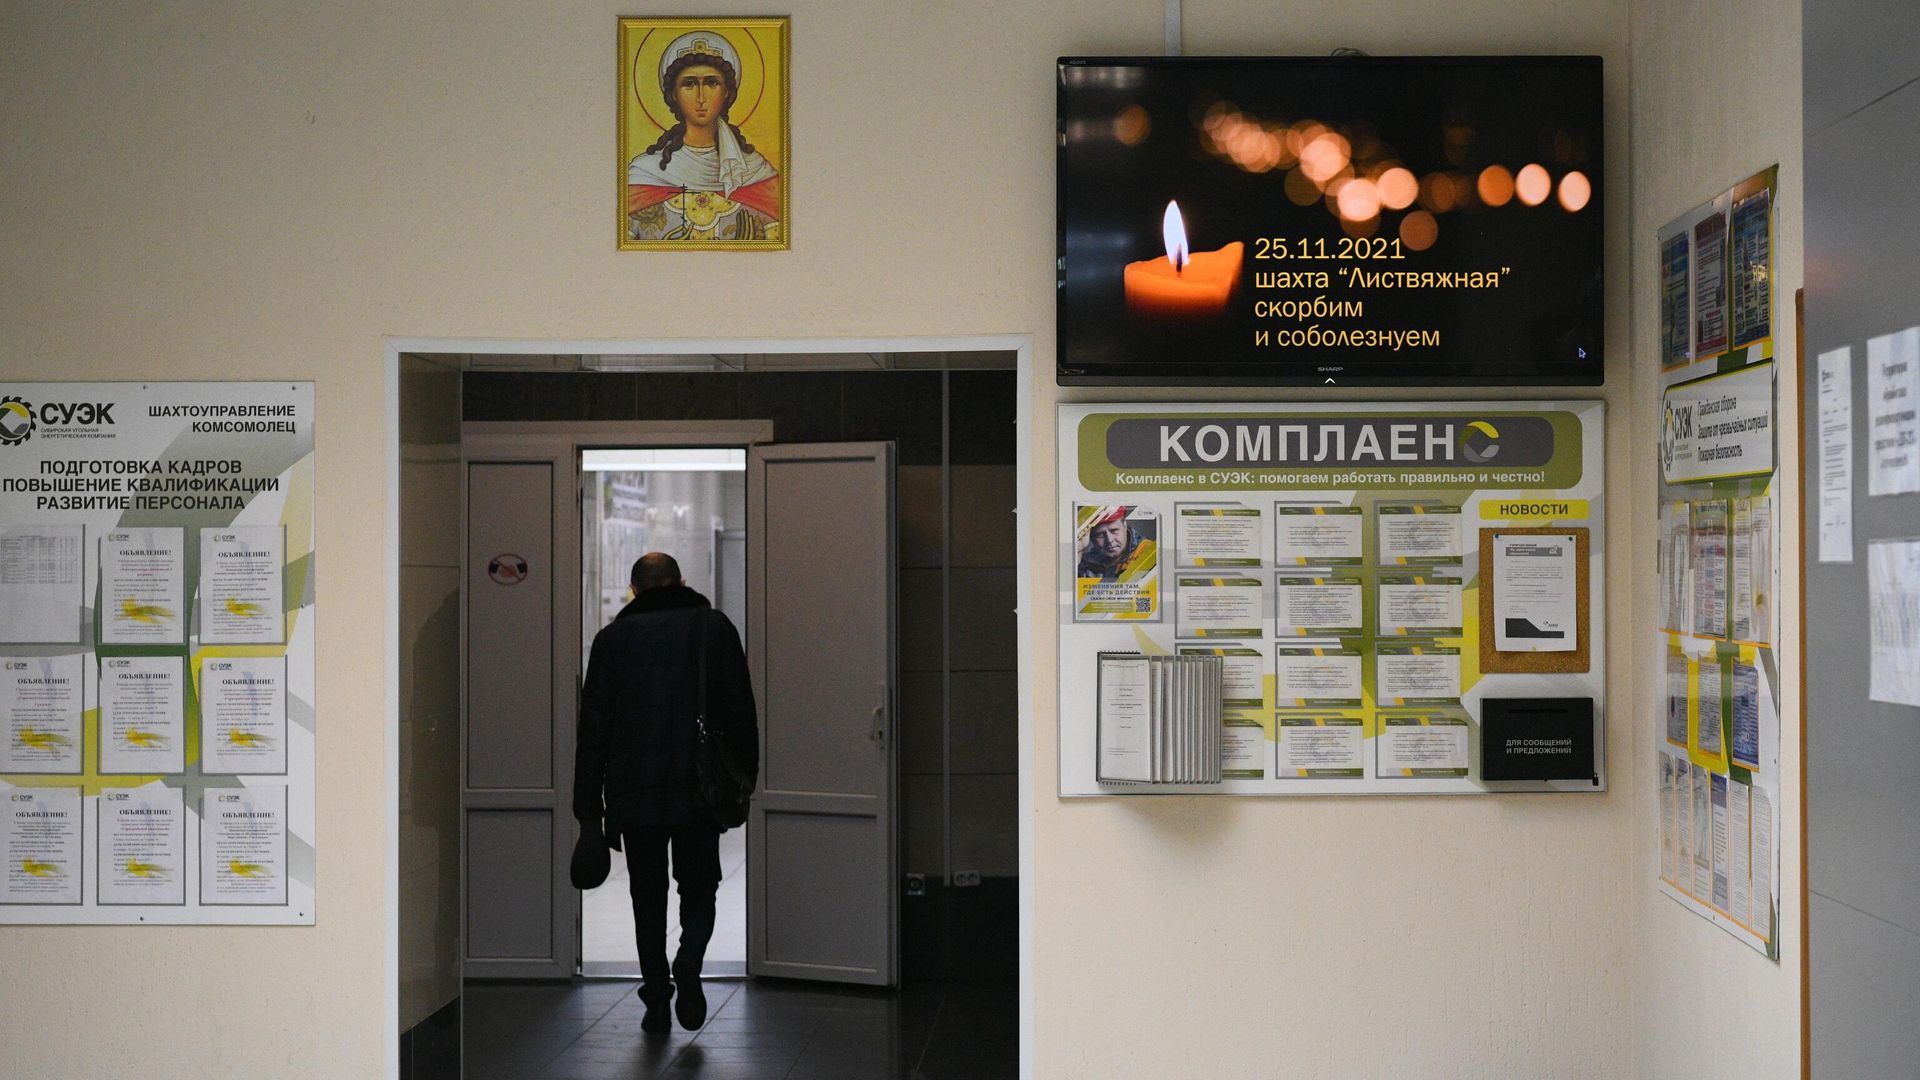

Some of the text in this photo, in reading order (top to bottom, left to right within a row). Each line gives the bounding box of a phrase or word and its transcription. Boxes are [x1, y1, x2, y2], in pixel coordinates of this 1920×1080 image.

[1255, 237, 1406, 260] 25.11.2021
[1255, 271, 1329, 289] шахта
[1254, 295, 1363, 321] скорбим
[1255, 324, 1440, 351] и соболезнуем
[40, 402, 115, 425] СУЭК
[148, 405, 296, 418] ШАХТОУПРАВЛЕНИЕ
[192, 421, 296, 435] КОМСОМОЛЕЦ
[1675, 405, 1693, 441] СУЭК
[40, 460, 242, 477] ПОДГОТОВКА КАДРОВ
[3, 477, 279, 494] ПОВЫШЕНИЕ КВАЛИФИКАЦИИ
[1116, 471, 1545, 486] Комплаенс в СУЭК: помогаем работать правильно и честно!
[37, 496, 245, 510] РАЗВИТИЕ ПЕРСОНАЛА
[1500, 504, 1569, 516] НОВОСТИ
[1506, 738, 1572, 747] ДЛЯ СООБЩЕНИЙ
[1514, 746, 1572, 755] ПРЕДЛОЖЕНИЙ
